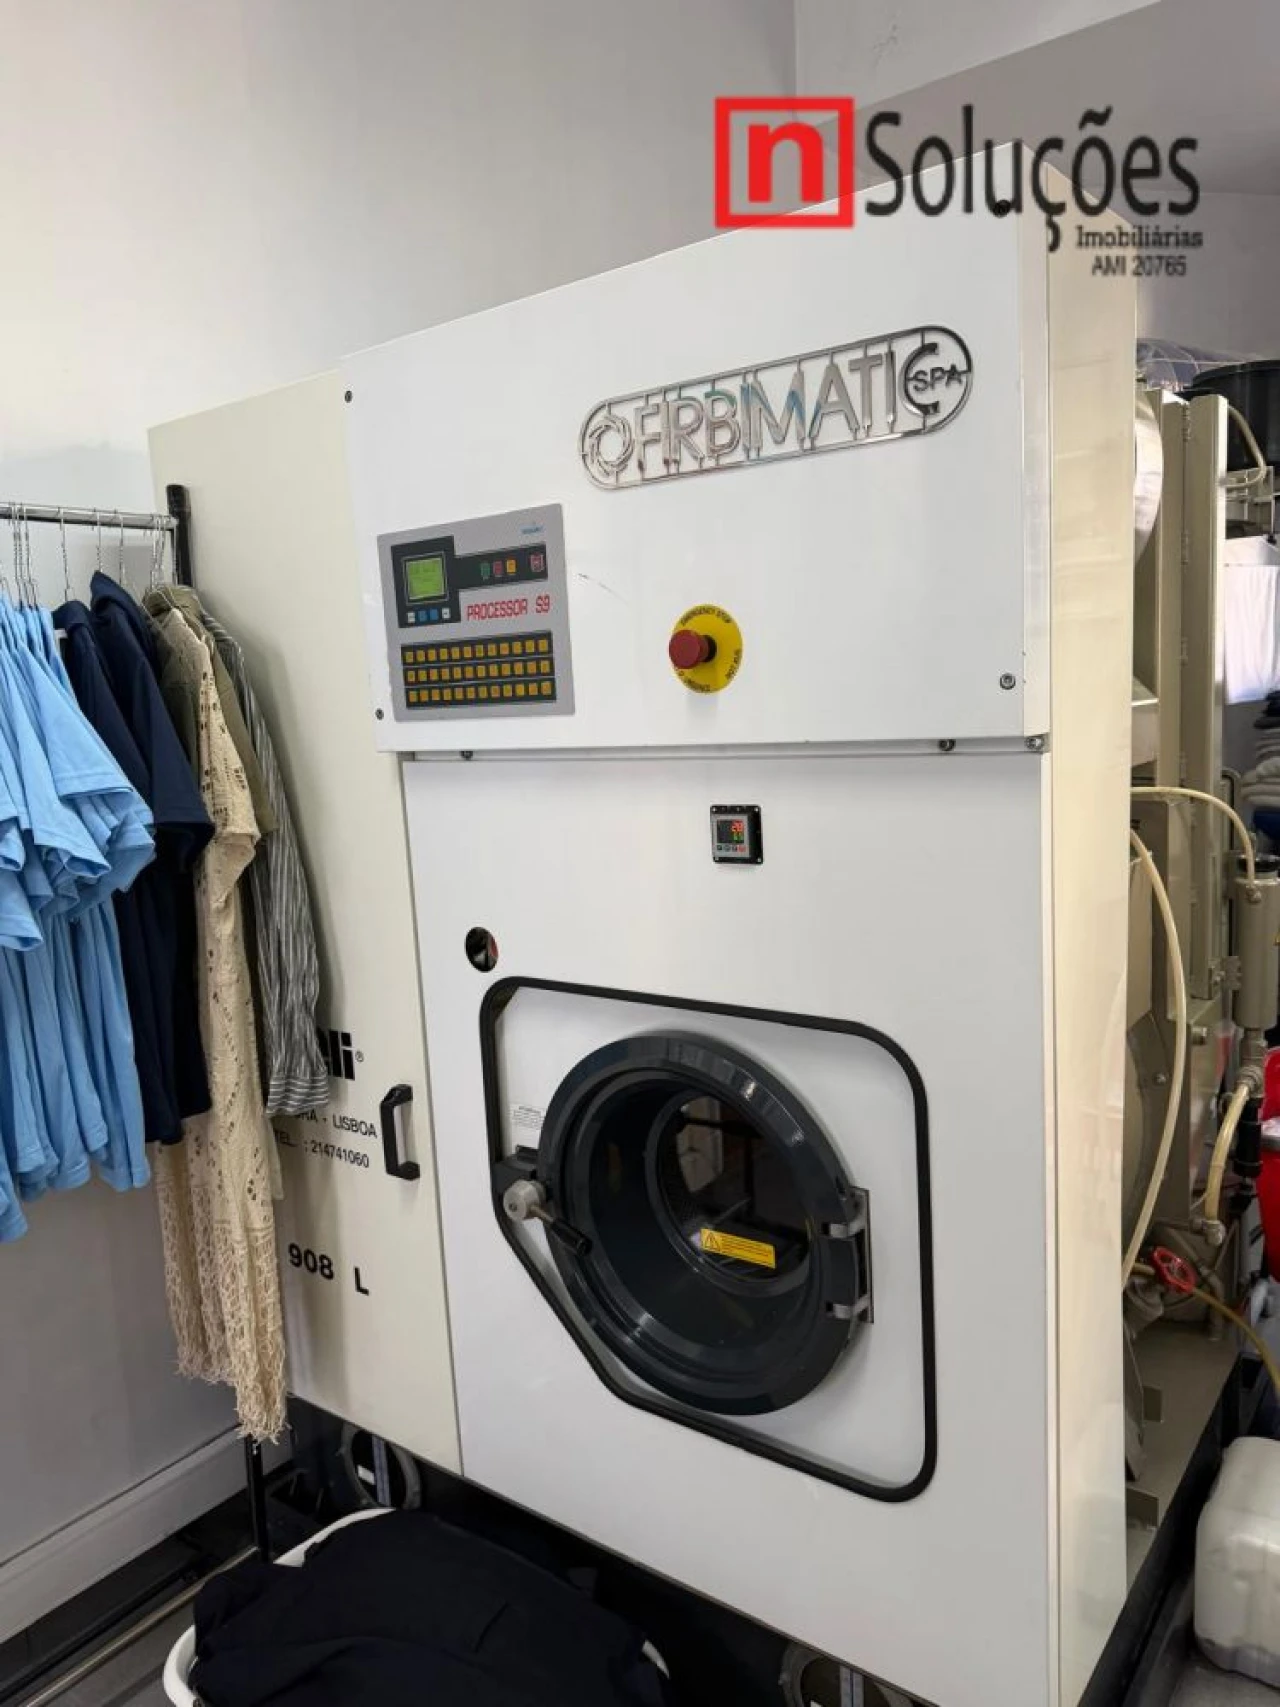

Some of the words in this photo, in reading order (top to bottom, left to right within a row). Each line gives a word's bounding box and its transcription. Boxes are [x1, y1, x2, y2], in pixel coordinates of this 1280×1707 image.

[912, 364, 962, 392] SPA
[466, 598, 528, 622] PROCESSOR
[535, 594, 551, 614] S9
[332, 1113, 378, 1139] LISBOA
[289, 1242, 334, 1280] 908
[354, 1266, 370, 1296] L
